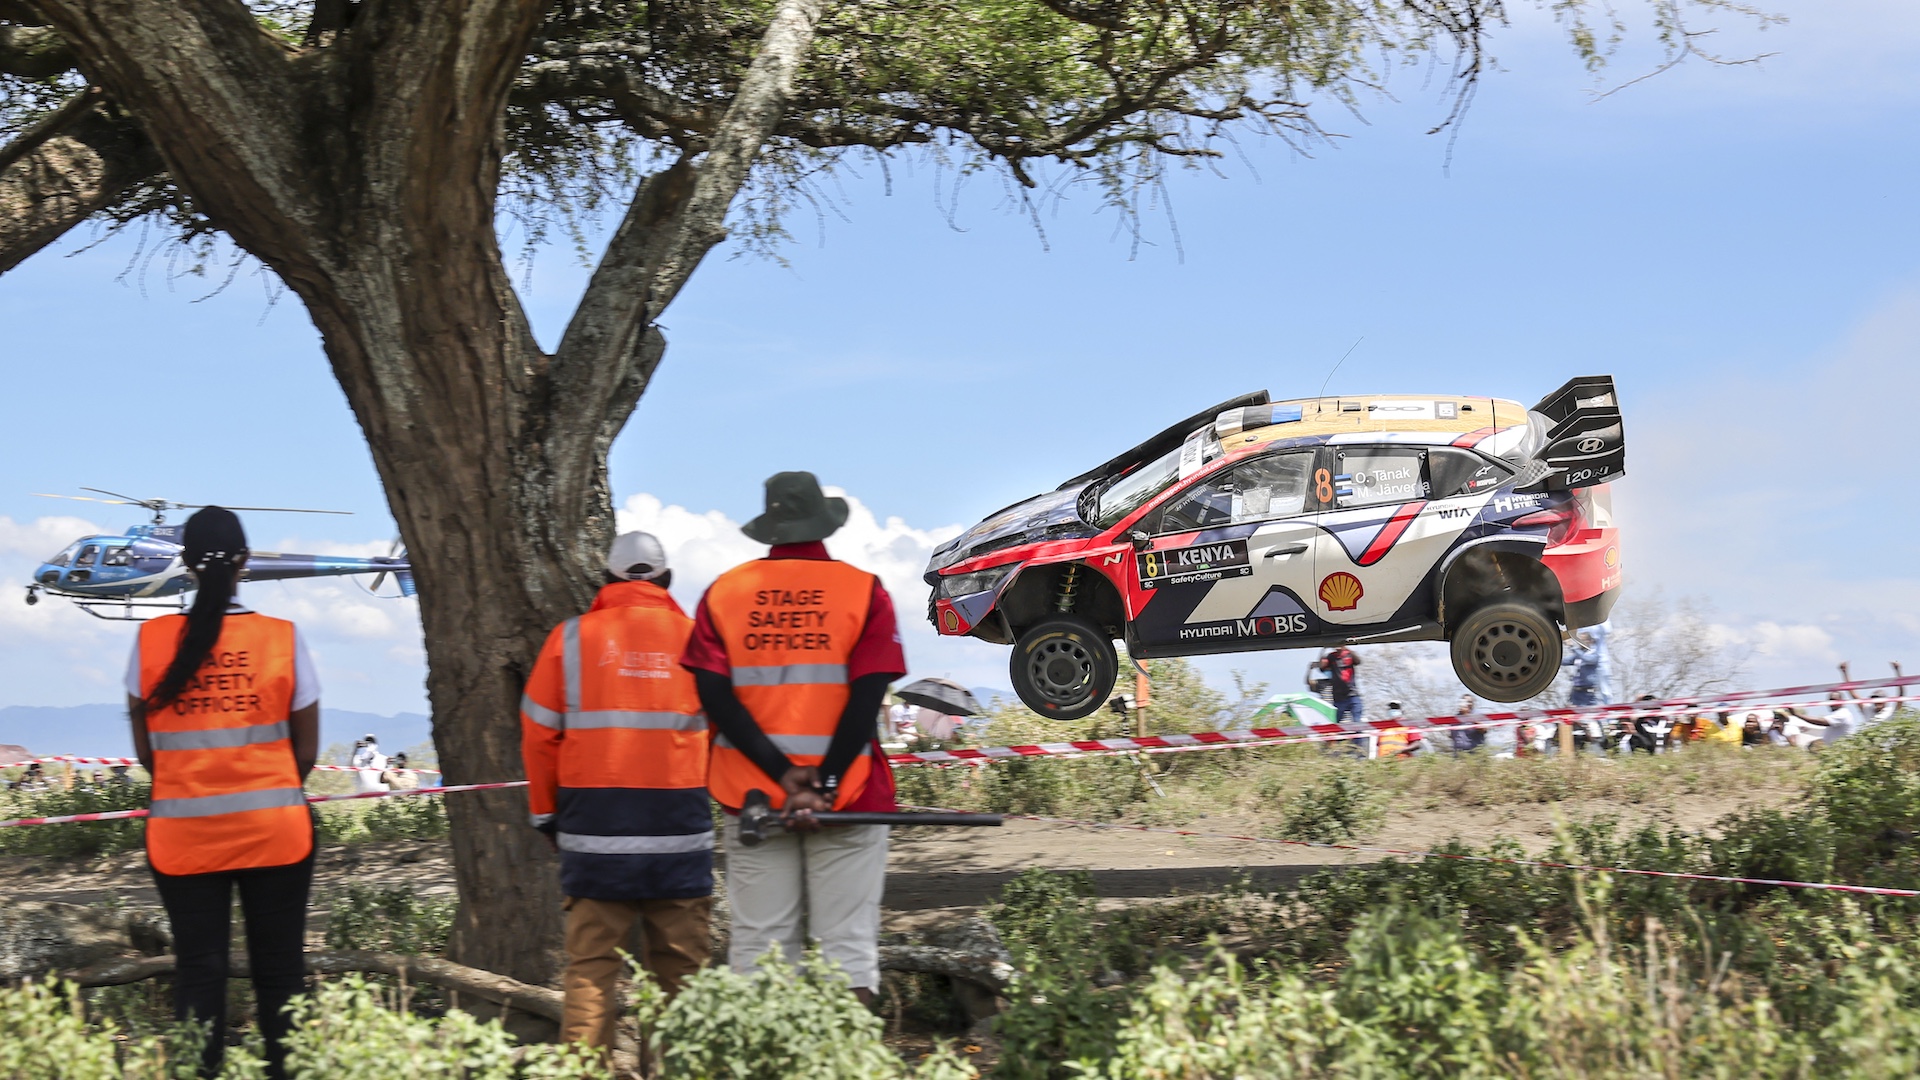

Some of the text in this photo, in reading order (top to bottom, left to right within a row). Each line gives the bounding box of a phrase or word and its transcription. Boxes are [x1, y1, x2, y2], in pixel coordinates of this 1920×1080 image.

[1148, 460, 1226, 508] motorsport.hyundai.com
[1355, 467, 1411, 484] O. Tänak
[1315, 468, 1333, 503] 8
[1357, 486, 1372, 498] M.
[1511, 492, 1550, 503] HYUNDAI
[1513, 500, 1542, 509] STEEL
[1178, 544, 1235, 566] KENYA
[1145, 553, 1158, 578] 8
[1170, 572, 1222, 585] SafetyCulture
[755, 589, 825, 606] STAGE
[747, 610, 830, 628] SAFETY
[1179, 613, 1308, 639] HYUNDAI MOBIS
[742, 632, 832, 651] OFFICER
[184, 672, 257, 692] AFETY
[173, 694, 262, 716] OFFICER
